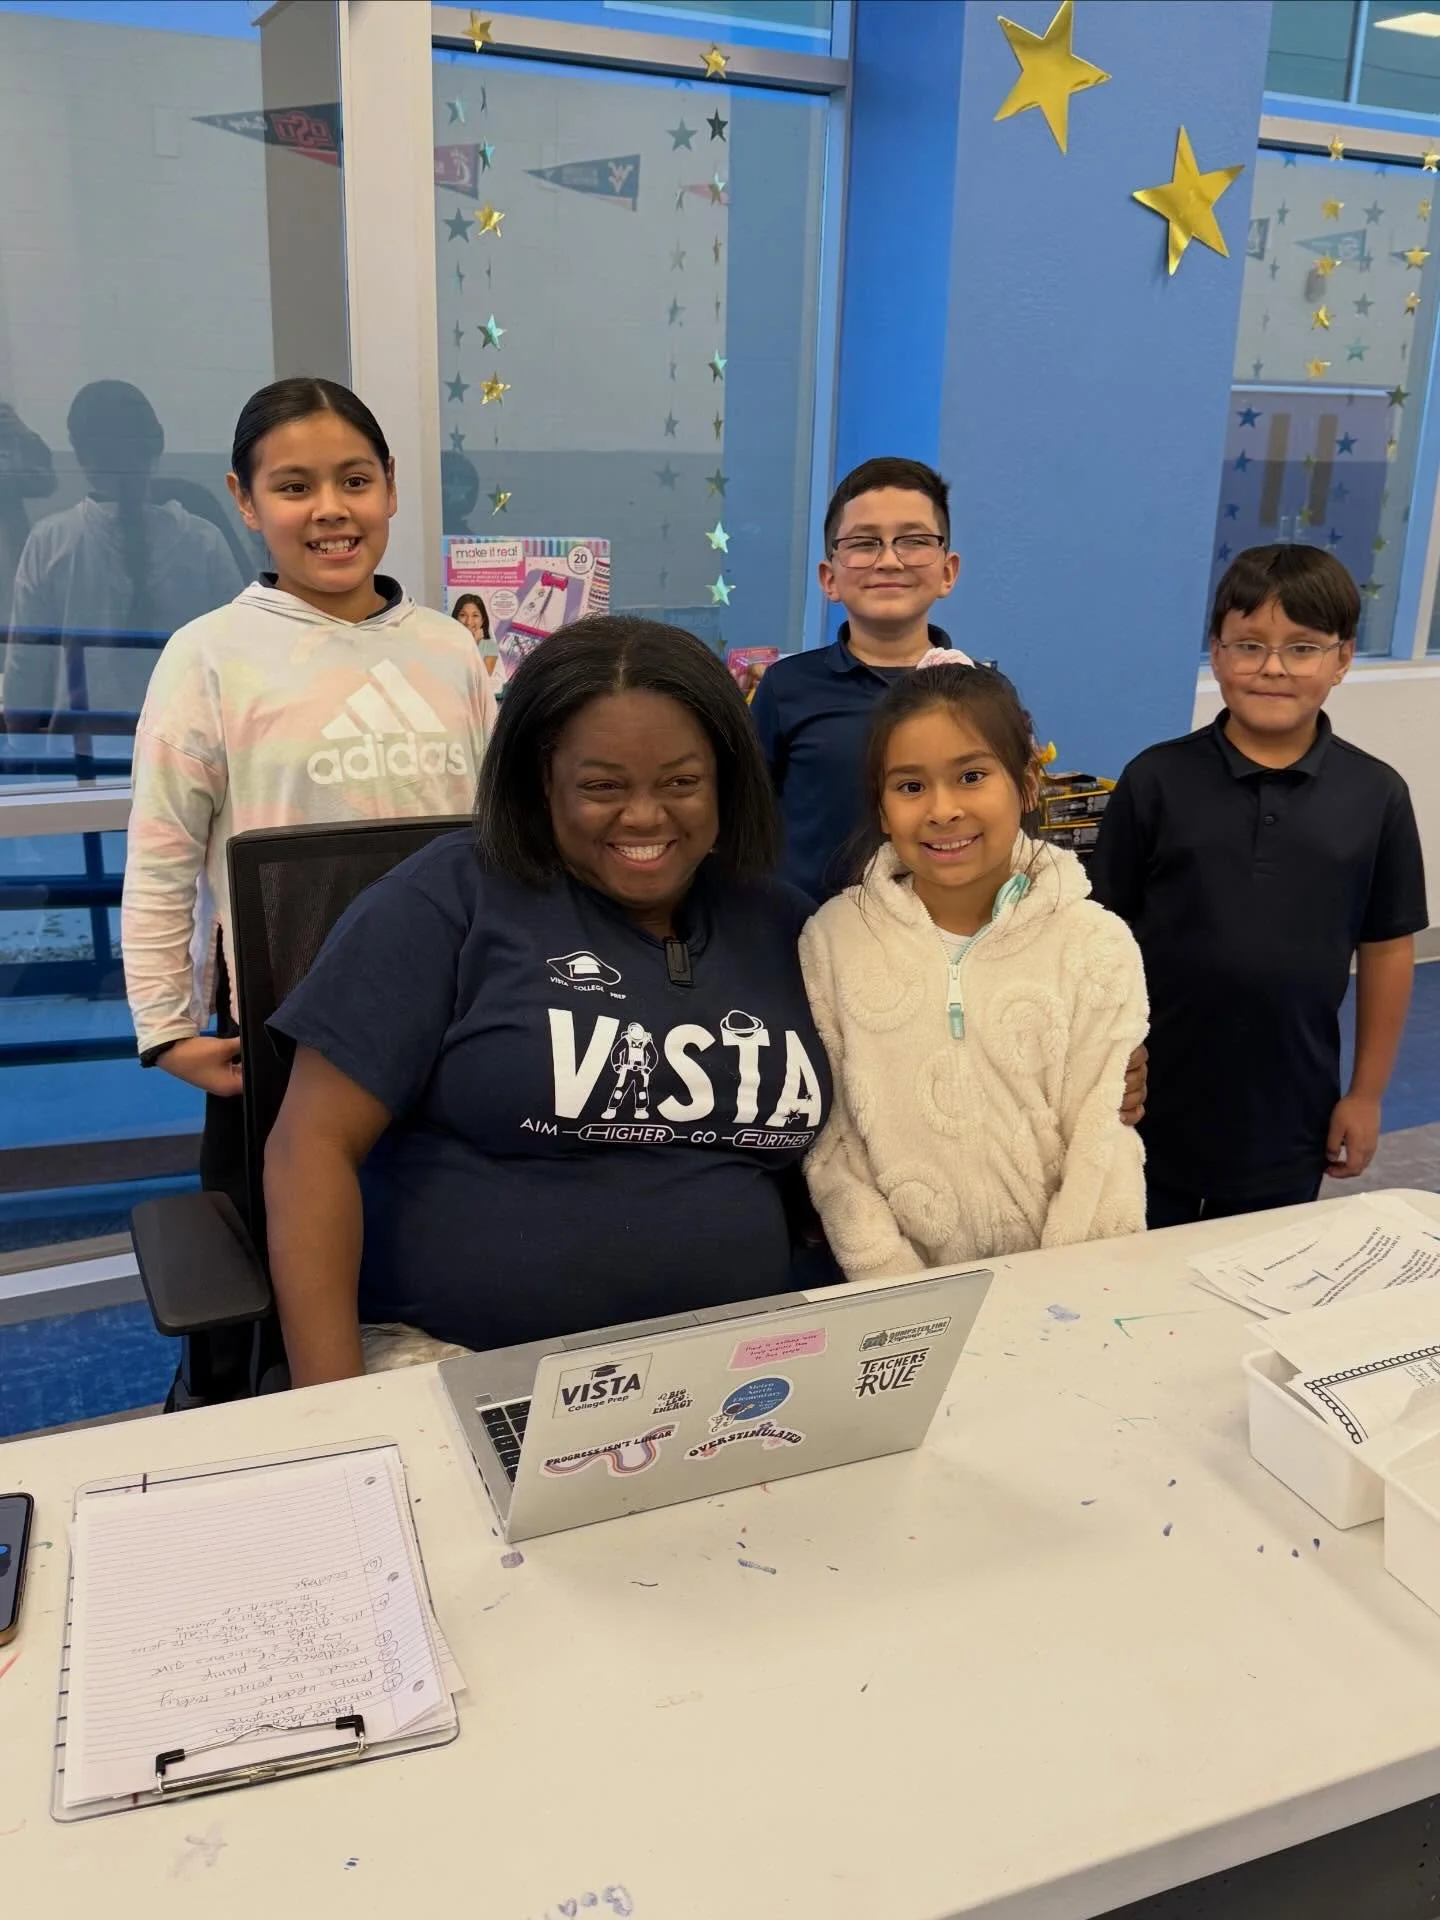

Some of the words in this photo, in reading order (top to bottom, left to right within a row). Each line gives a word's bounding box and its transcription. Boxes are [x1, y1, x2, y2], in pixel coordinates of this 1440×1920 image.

[456, 547, 487, 559] make
[489, 547, 496, 557] it
[498, 546, 518, 557] real
[573, 553, 588, 564] 20
[307, 731, 467, 785] adidas
[550, 976, 569, 987] VISTA
[610, 992, 627, 1000] PREP
[520, 1118, 558, 1136] AIM
[585, 1127, 666, 1142] HIGHER
[690, 1131, 716, 1143] GO
[741, 1132, 809, 1146] FURTHER
[889, 1325, 930, 1339] DUMPSTER
[859, 1348, 930, 1375] TEACHERS
[561, 1373, 641, 1406] VISTA
[747, 1387, 773, 1395] North
[748, 1381, 775, 1390] Metro
[855, 1364, 924, 1397] RULE
[568, 1401, 605, 1412] College
[607, 1394, 630, 1404] Prep
[667, 1388, 687, 1399] BIG
[652, 1399, 694, 1415] ENERGY
[545, 1447, 600, 1467] PROGRESS
[602, 1440, 632, 1453] ISN'T
[634, 1430, 672, 1447] LINEAR
[688, 1427, 802, 1458] OVERSTIMULATED
